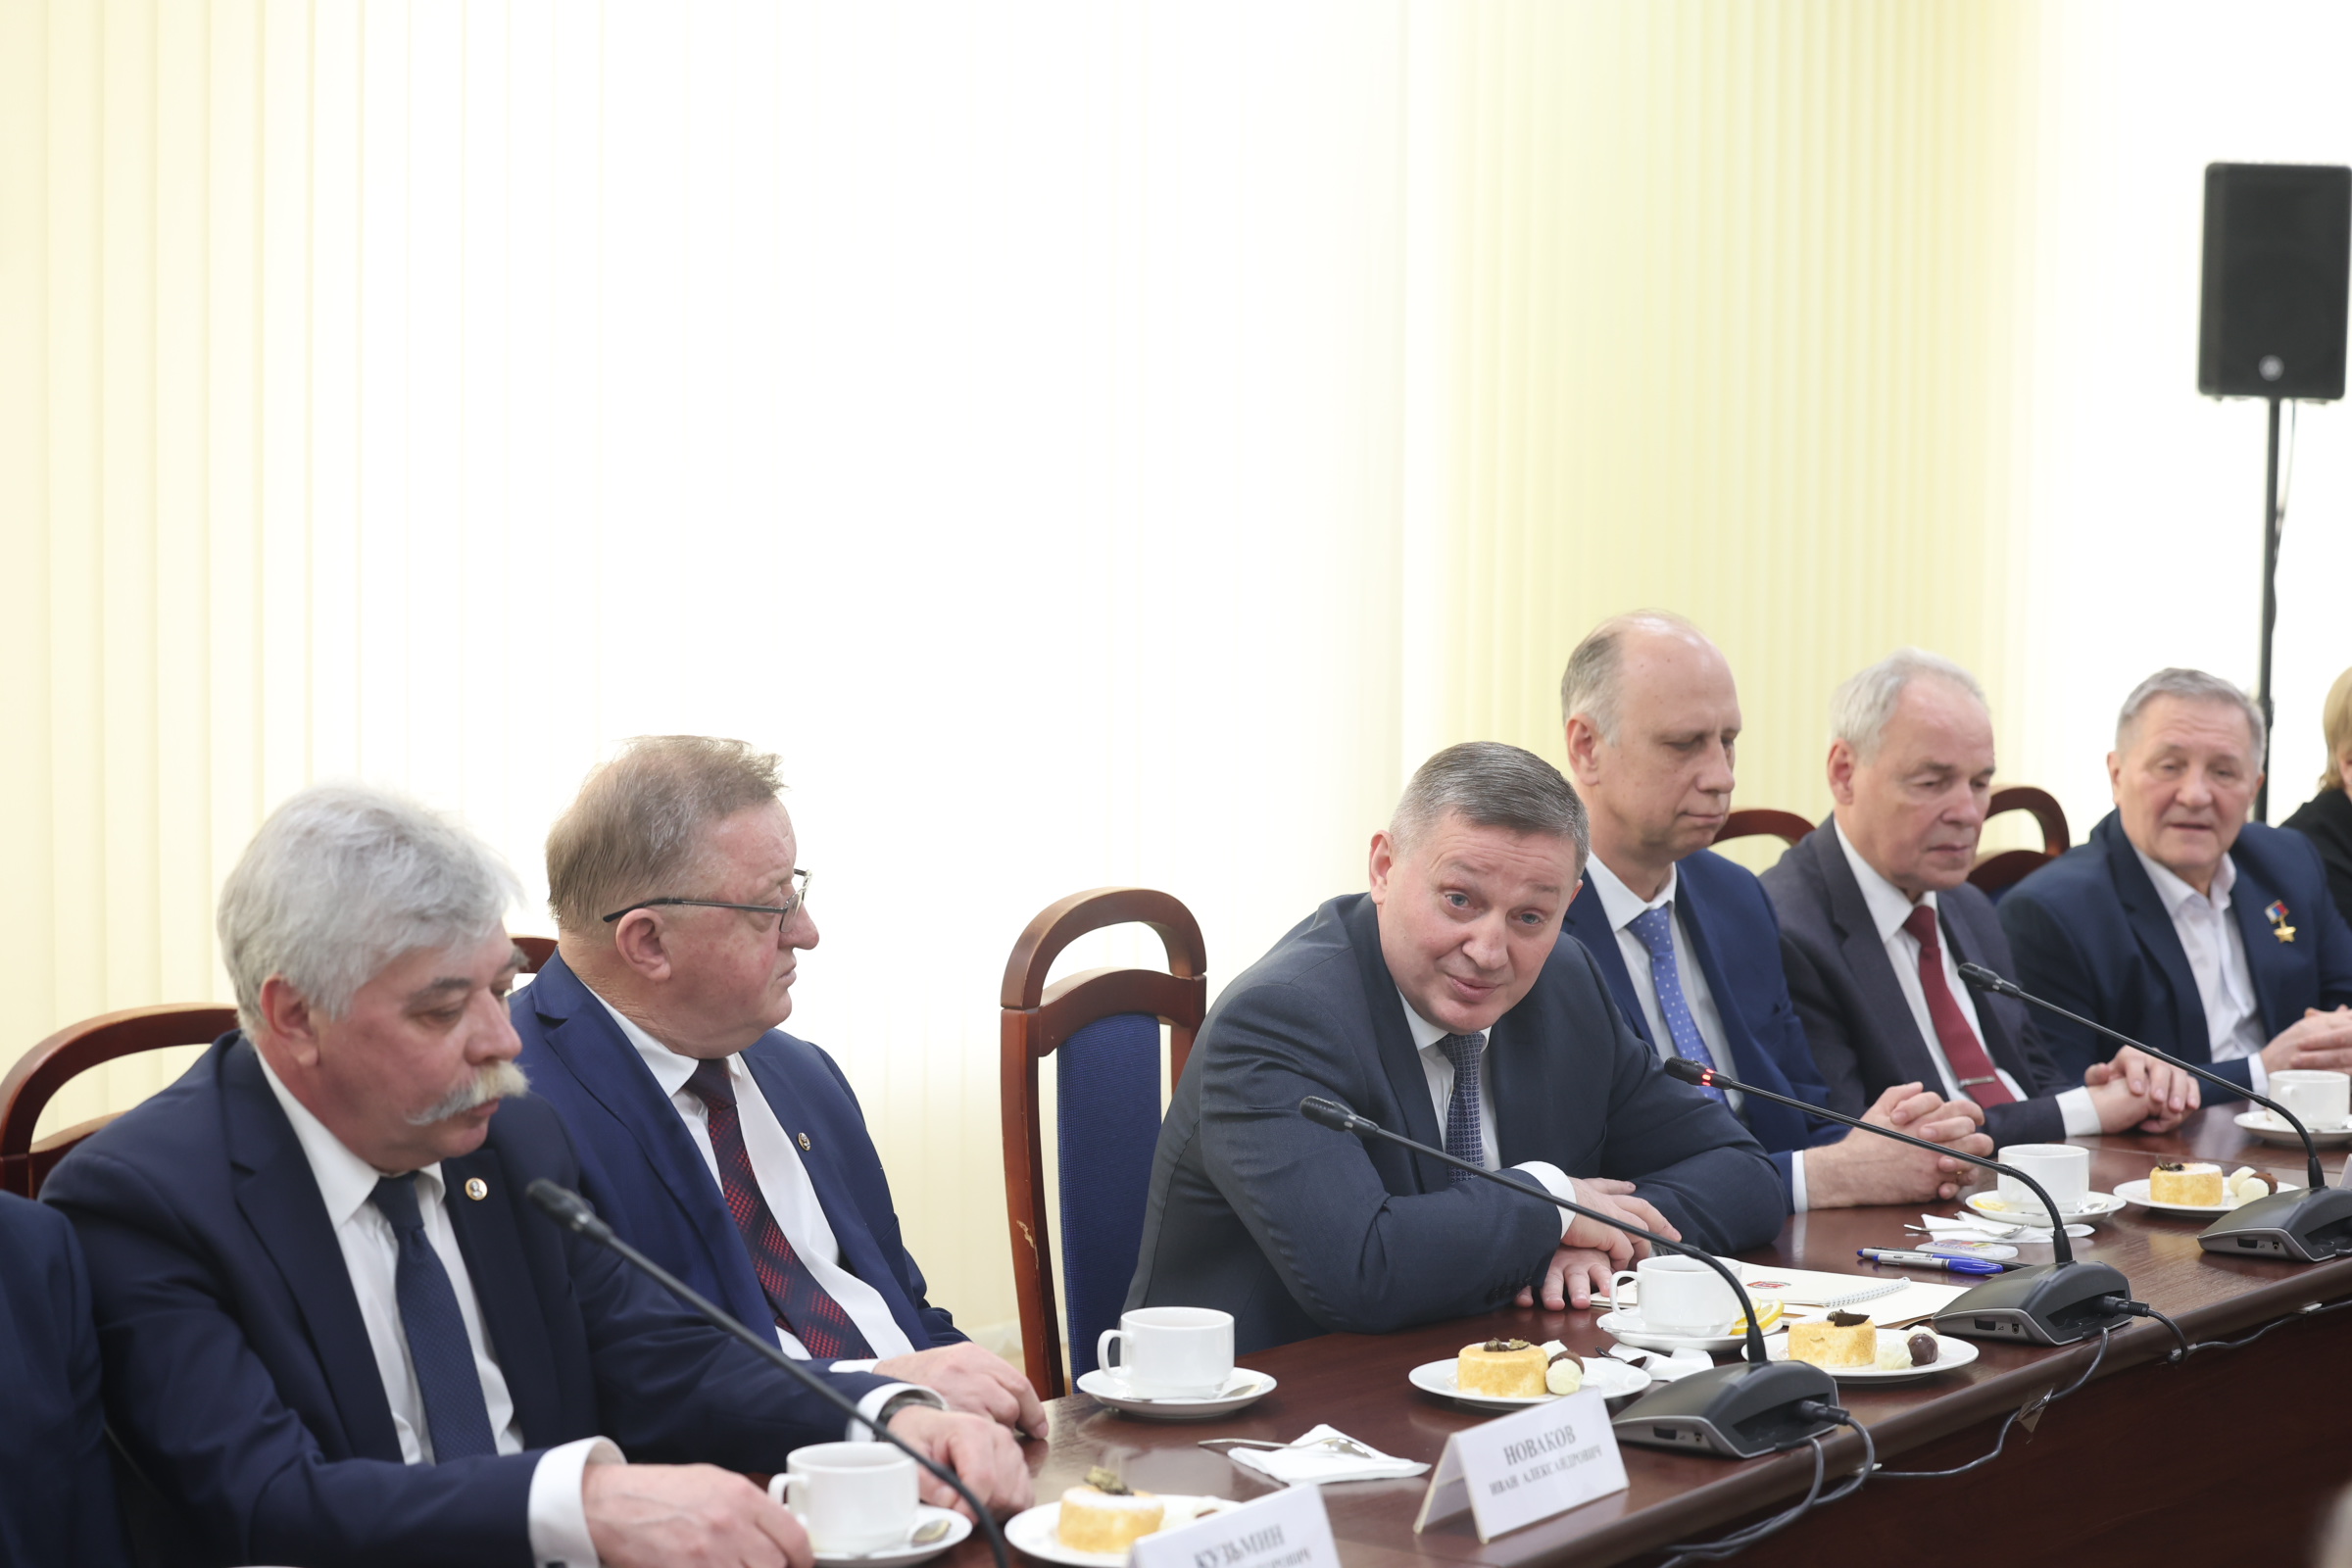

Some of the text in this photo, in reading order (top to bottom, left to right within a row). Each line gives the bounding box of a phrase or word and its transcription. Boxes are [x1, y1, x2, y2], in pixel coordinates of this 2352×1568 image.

[1502, 1424, 1577, 1467] НОВАКОВ
[1489, 1445, 1603, 1496] ИВАН АЛЕКСАНДРОВИЧ
[1193, 1523, 1287, 1568] КУЗЬМИН
